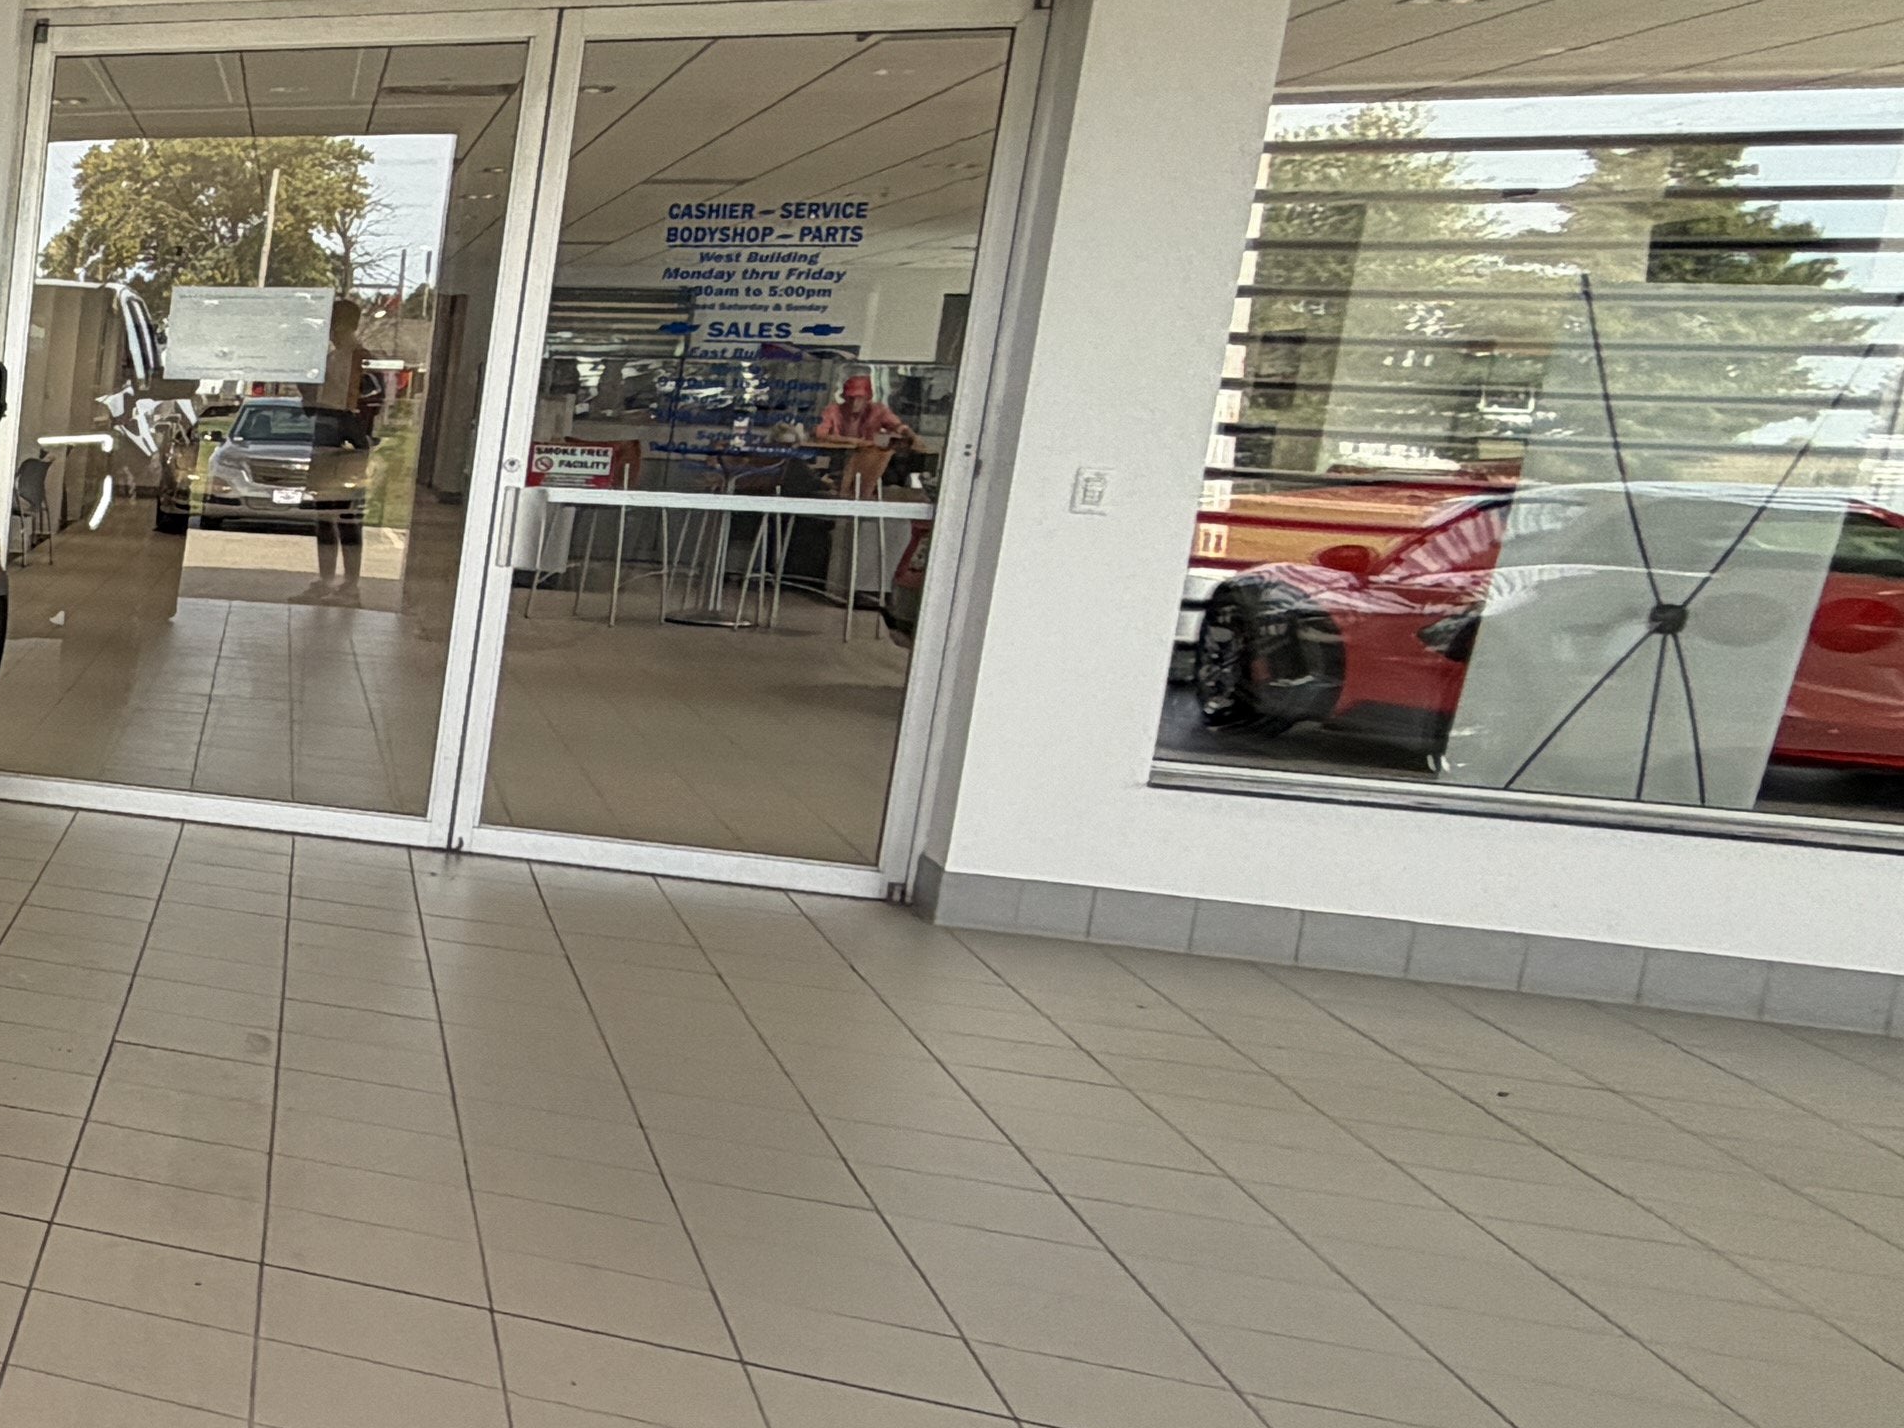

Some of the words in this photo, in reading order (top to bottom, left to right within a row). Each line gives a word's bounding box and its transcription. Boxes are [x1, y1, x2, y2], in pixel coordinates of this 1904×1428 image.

[668, 202, 755, 220] CASHIER
[780, 201, 869, 219] SERVICE
[666, 226, 774, 243] BODYSHOP
[799, 225, 863, 243] PARTS
[699, 251, 741, 263] West
[747, 251, 821, 265] Building
[662, 267, 736, 283] Monday
[742, 268, 780, 280] thru
[785, 267, 847, 283] Friday
[745, 286, 763, 297] to
[768, 285, 832, 300] 5:00pm
[707, 321, 792, 339] SALES
[689, 346, 729, 359] East
[535, 446, 577, 456] SMOKE
[580, 448, 609, 457] FREE
[558, 459, 608, 470] FACILITY
